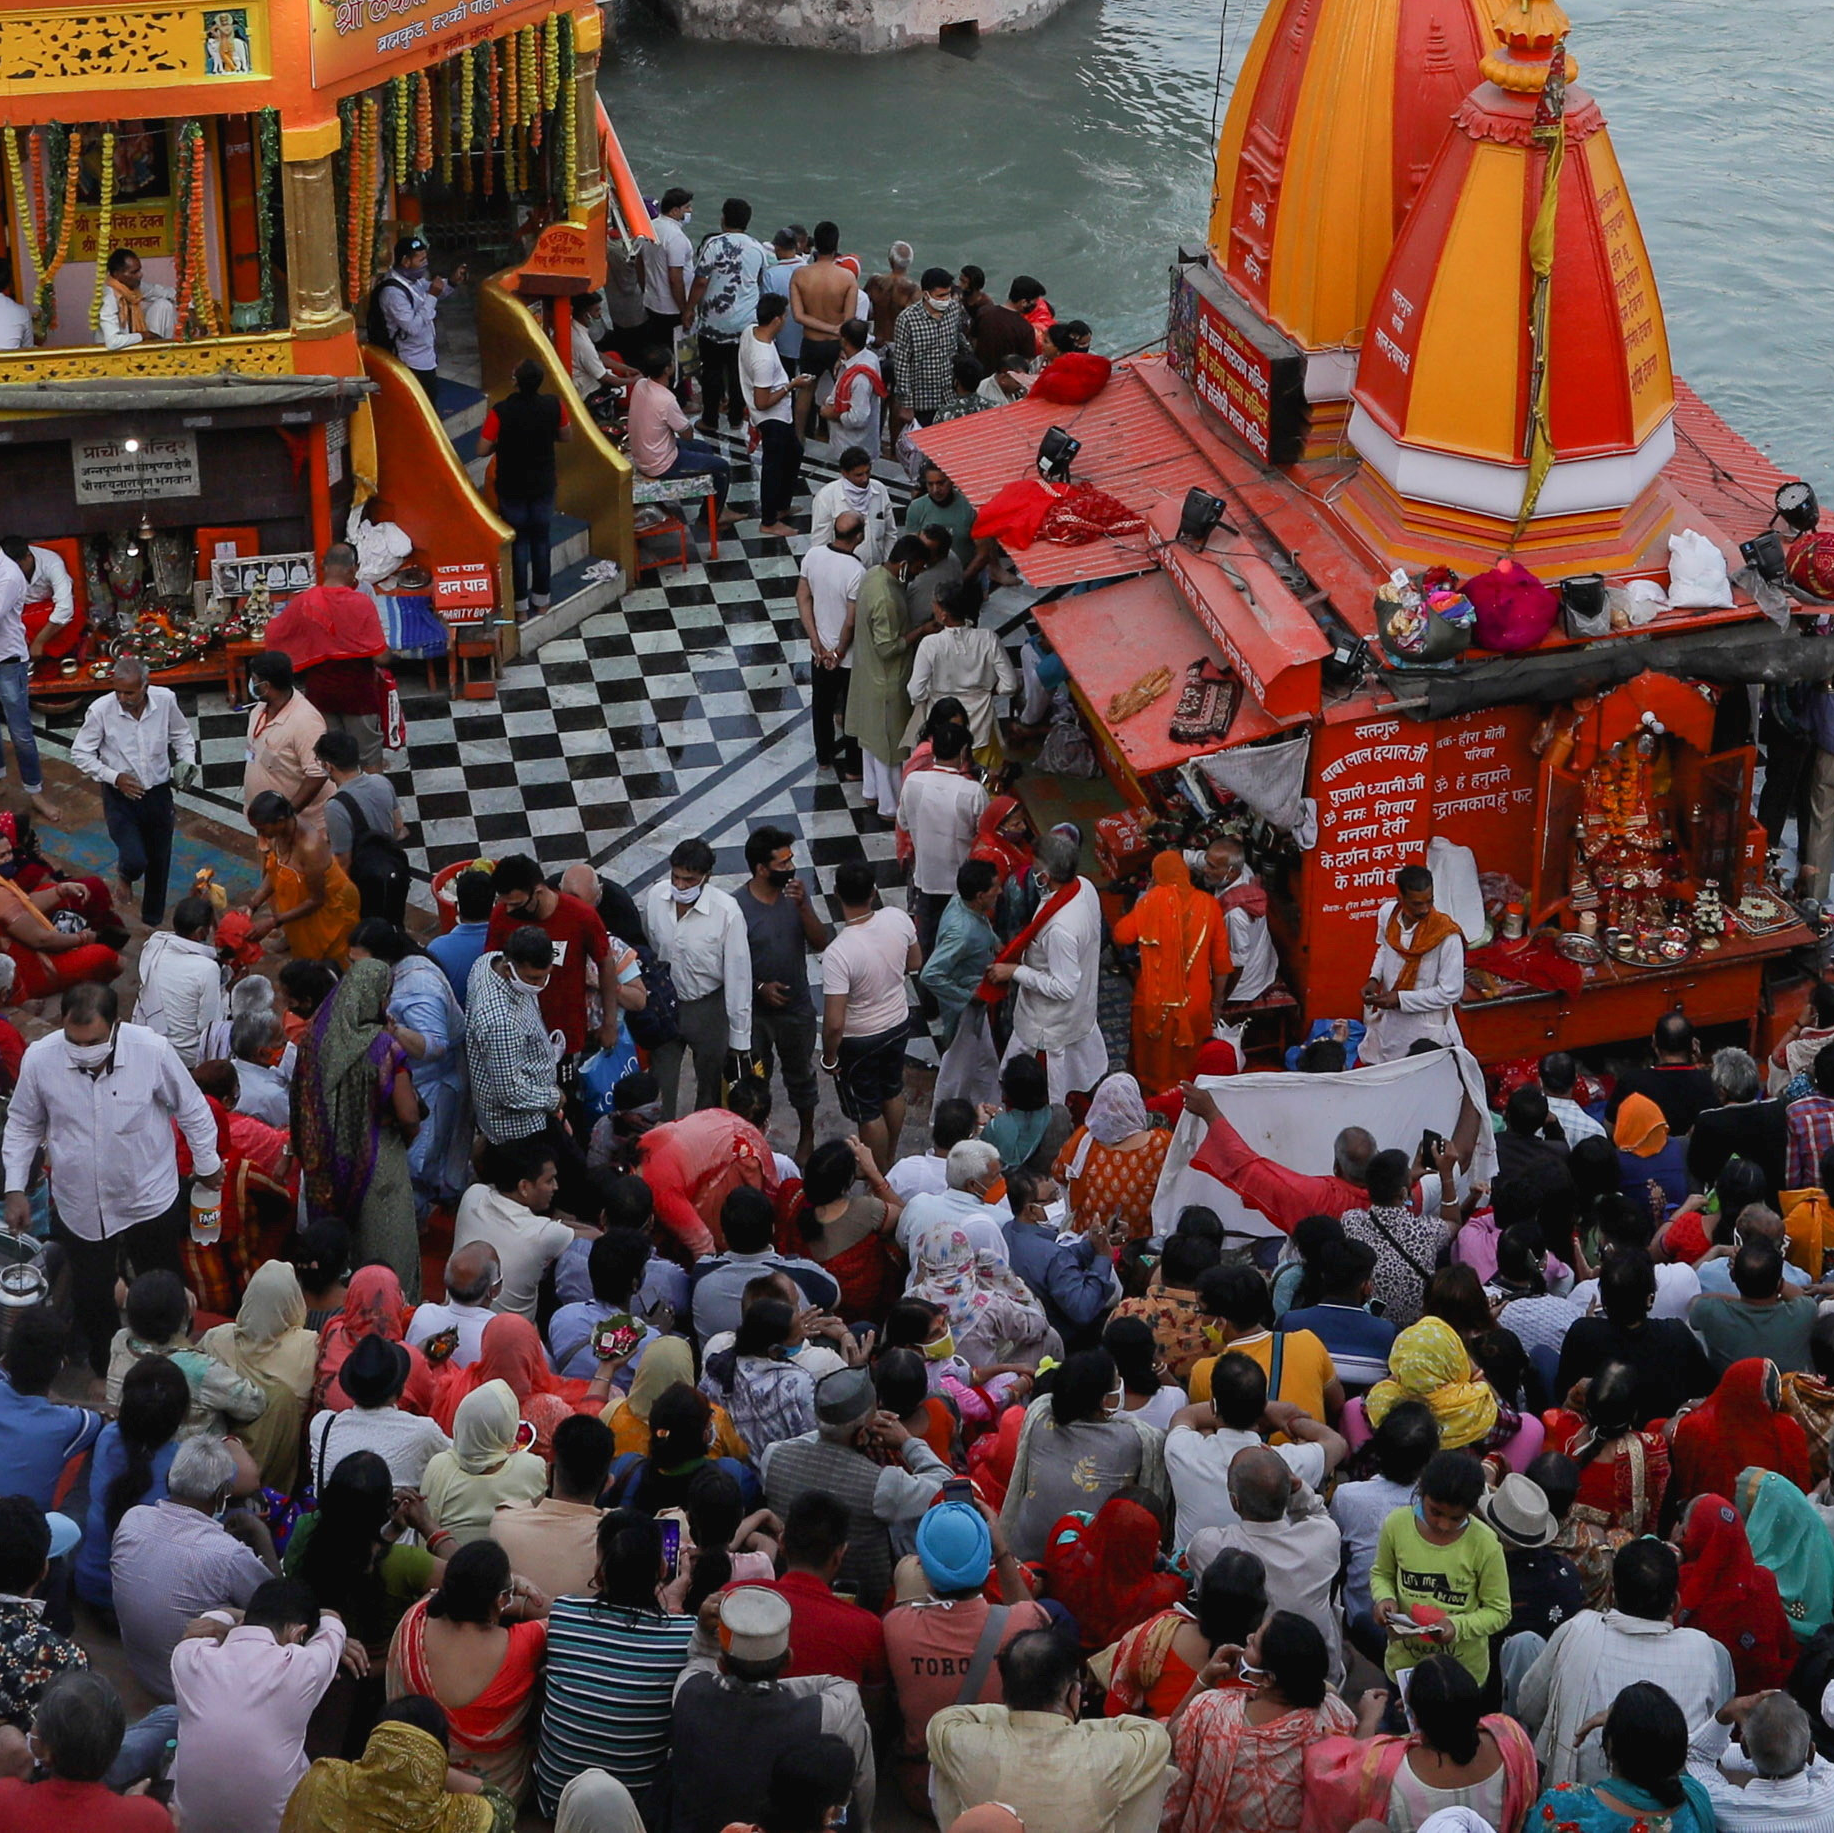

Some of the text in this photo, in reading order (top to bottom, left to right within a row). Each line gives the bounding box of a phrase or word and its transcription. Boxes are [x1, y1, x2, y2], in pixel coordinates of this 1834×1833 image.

[431, 2, 467, 32] हरकी
[1199, 313, 1270, 401] श्री सत्य नारायण मन्दिर
[1198, 342, 1269, 429] श्री गंगा माता मन्दिर
[1196, 369, 1207, 396] श्री
[1229, 404, 1245, 437] माता
[1245, 420, 1269, 458] मन्दिर
[155, 475, 192, 486] भगवान
[438, 578, 488, 596] दान पात्र
[1354, 720, 1400, 741] सतगुरु
[1458, 725, 1506, 747] हीरा मोती
[1321, 758, 1347, 784] बाबा
[1345, 746, 1373, 767] लाल
[1464, 747, 1496, 762] परिवार
[1329, 772, 1426, 807] पुजारी ध्यानी जी
[1471, 765, 1511, 790] हनुमते
[1343, 809, 1367, 823] नमः
[1374, 799, 1417, 818] शिवाय
[1337, 818, 1410, 844] मनसा देवी
[1320, 840, 1425, 869] के दर्शन कर पुण्य
[1334, 867, 1385, 890] के भागी
[1422, 1576, 1438, 1587] ME
[1447, 1592, 1466, 1604] YOUR
